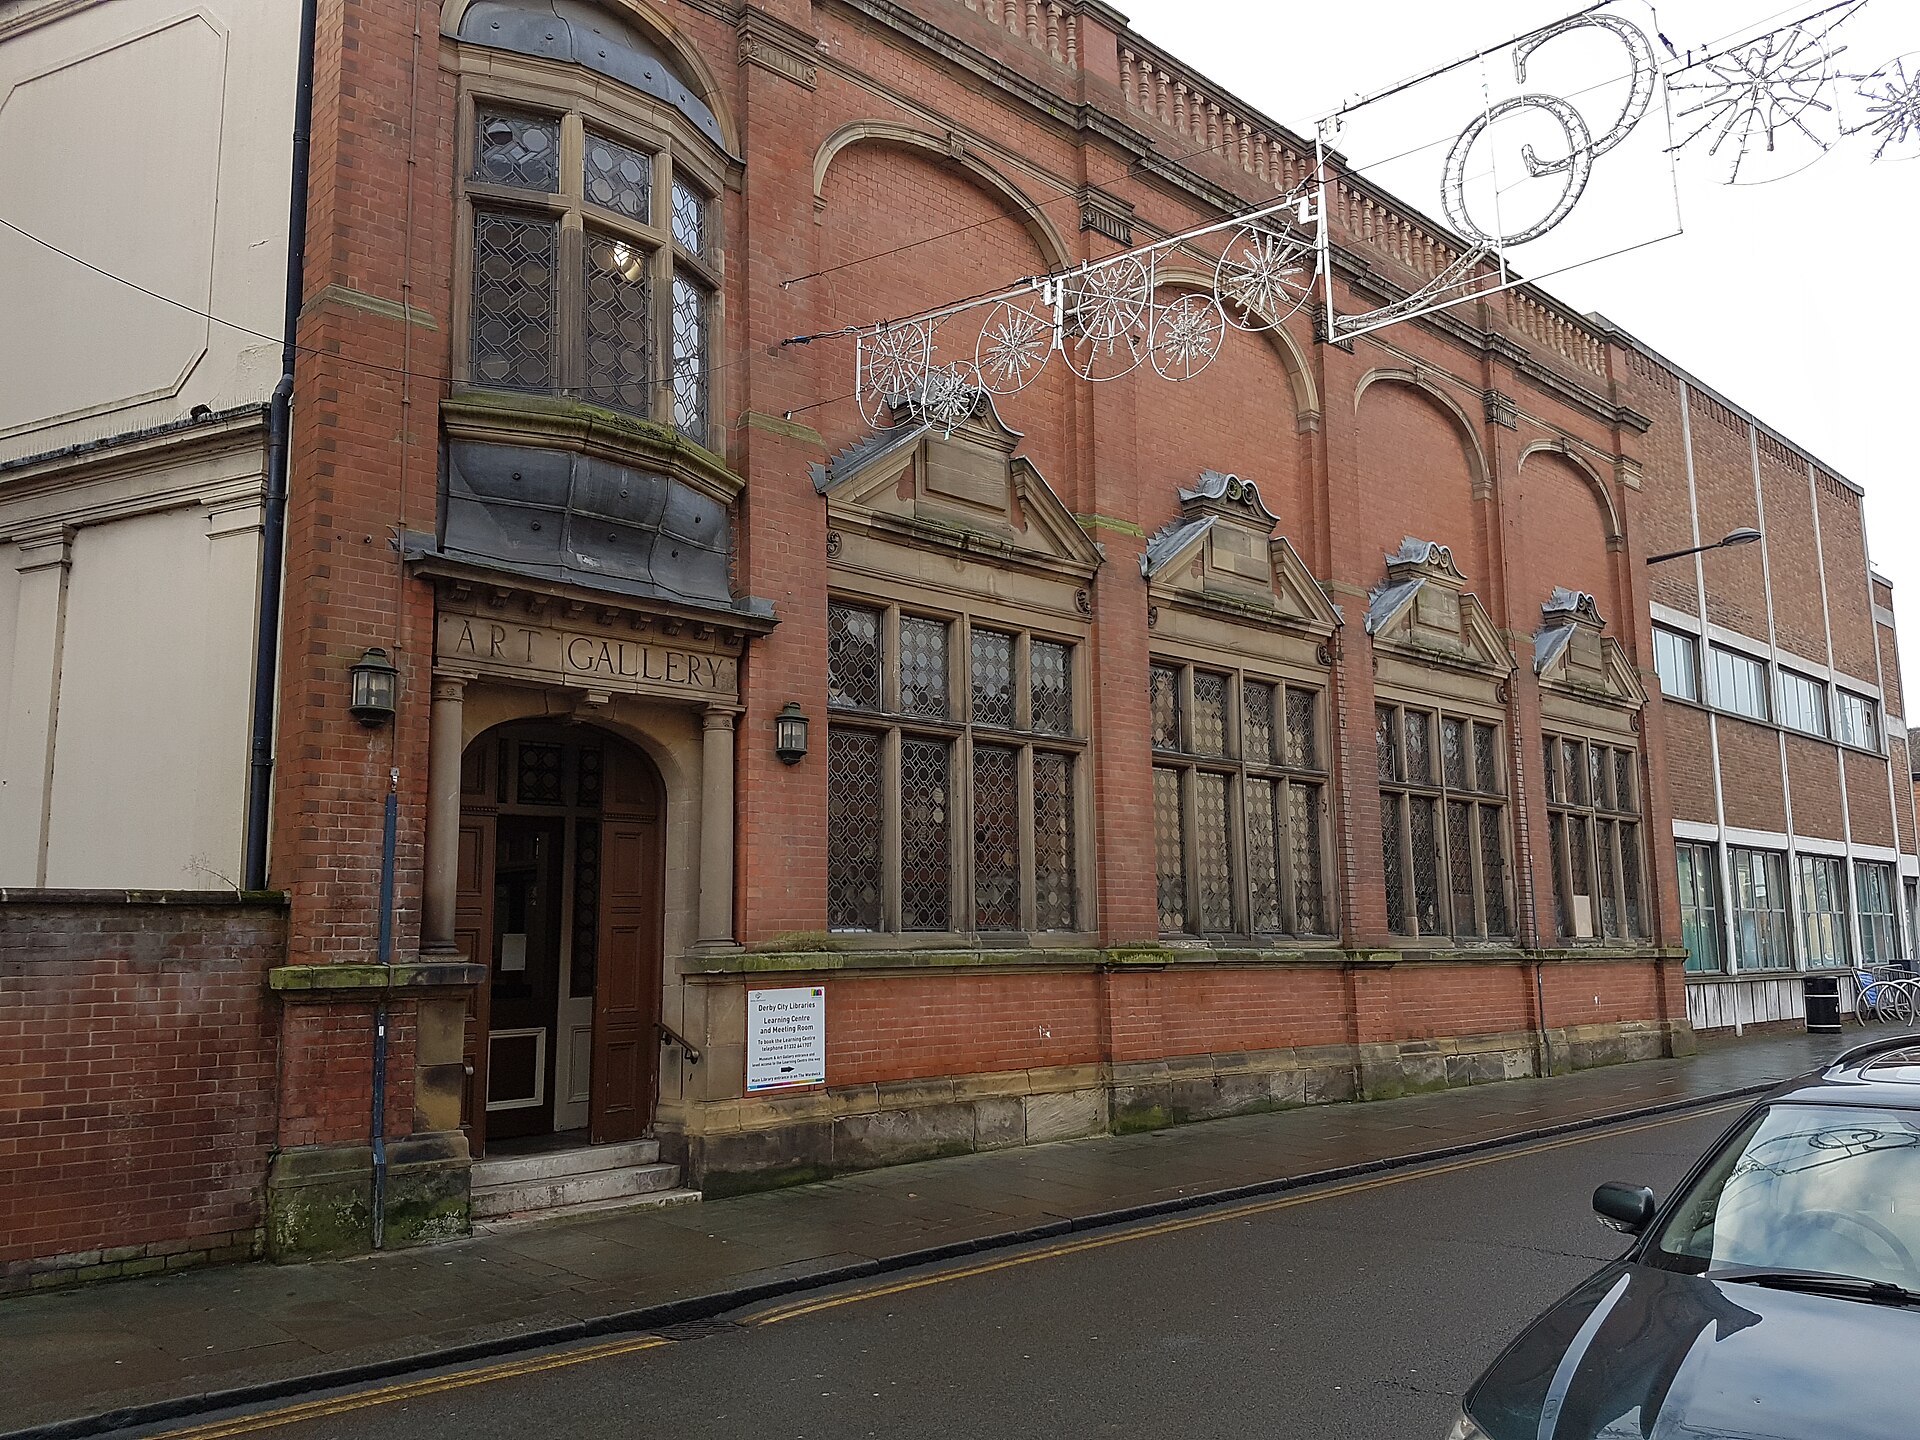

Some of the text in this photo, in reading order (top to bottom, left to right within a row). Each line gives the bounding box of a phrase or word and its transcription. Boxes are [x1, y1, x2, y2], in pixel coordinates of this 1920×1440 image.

[456, 619, 724, 688] ART GALLERY
[764, 1016, 790, 1024] Learning
